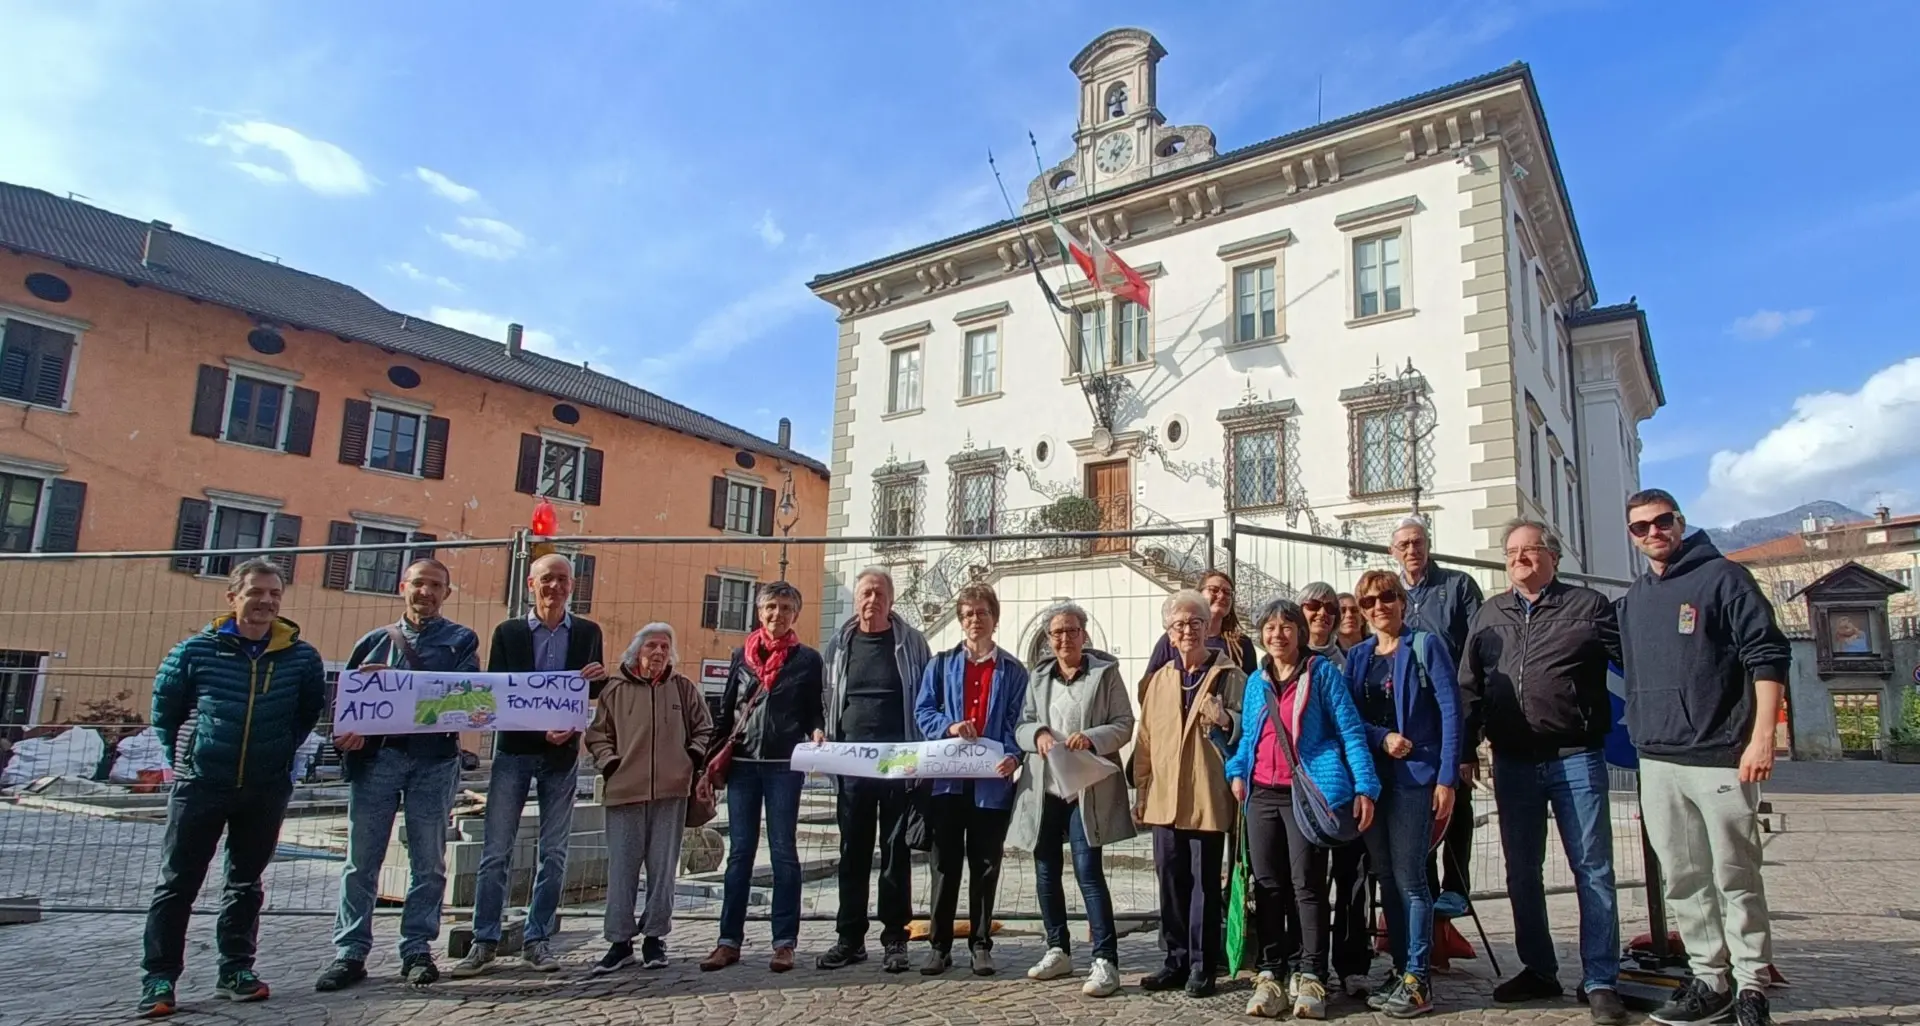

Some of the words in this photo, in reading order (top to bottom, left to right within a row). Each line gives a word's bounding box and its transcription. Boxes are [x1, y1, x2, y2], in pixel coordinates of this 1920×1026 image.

[345, 671, 413, 693] SALVI
[527, 674, 586, 692] ORTO
[339, 700, 394, 722] AMO
[507, 694, 583, 715] FONTANARI
